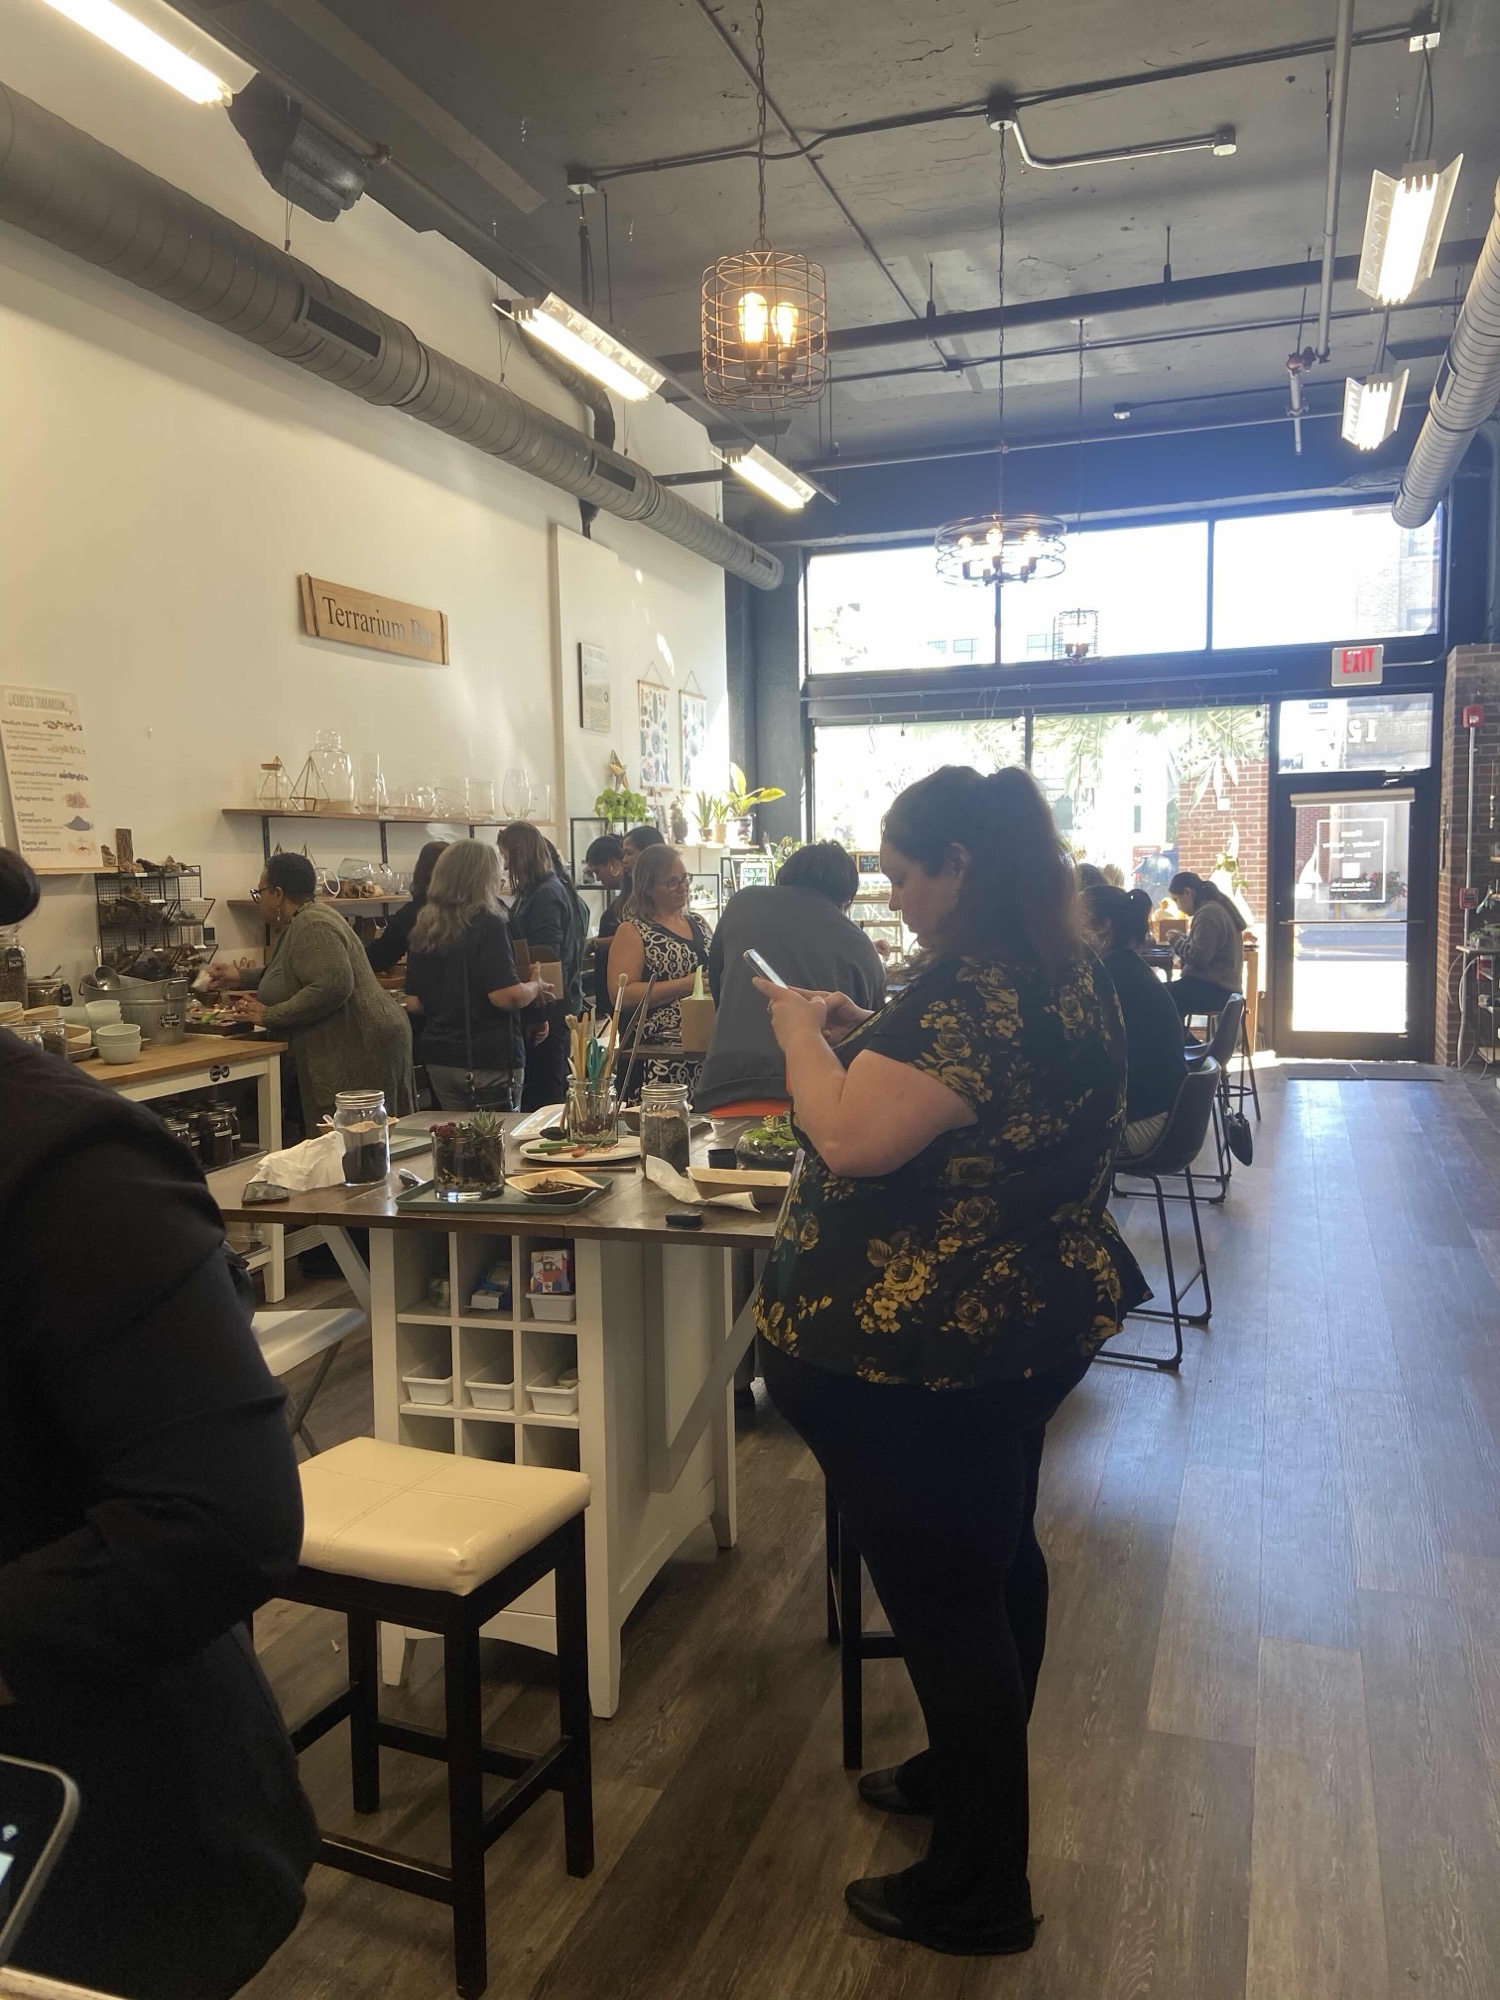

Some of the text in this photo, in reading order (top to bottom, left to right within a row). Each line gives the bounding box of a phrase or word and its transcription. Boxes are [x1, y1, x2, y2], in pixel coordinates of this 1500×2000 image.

[322, 596, 405, 640] Terrarium
[1341, 648, 1375, 673] EXIT
[14, 794, 41, 803] Sphagnum
